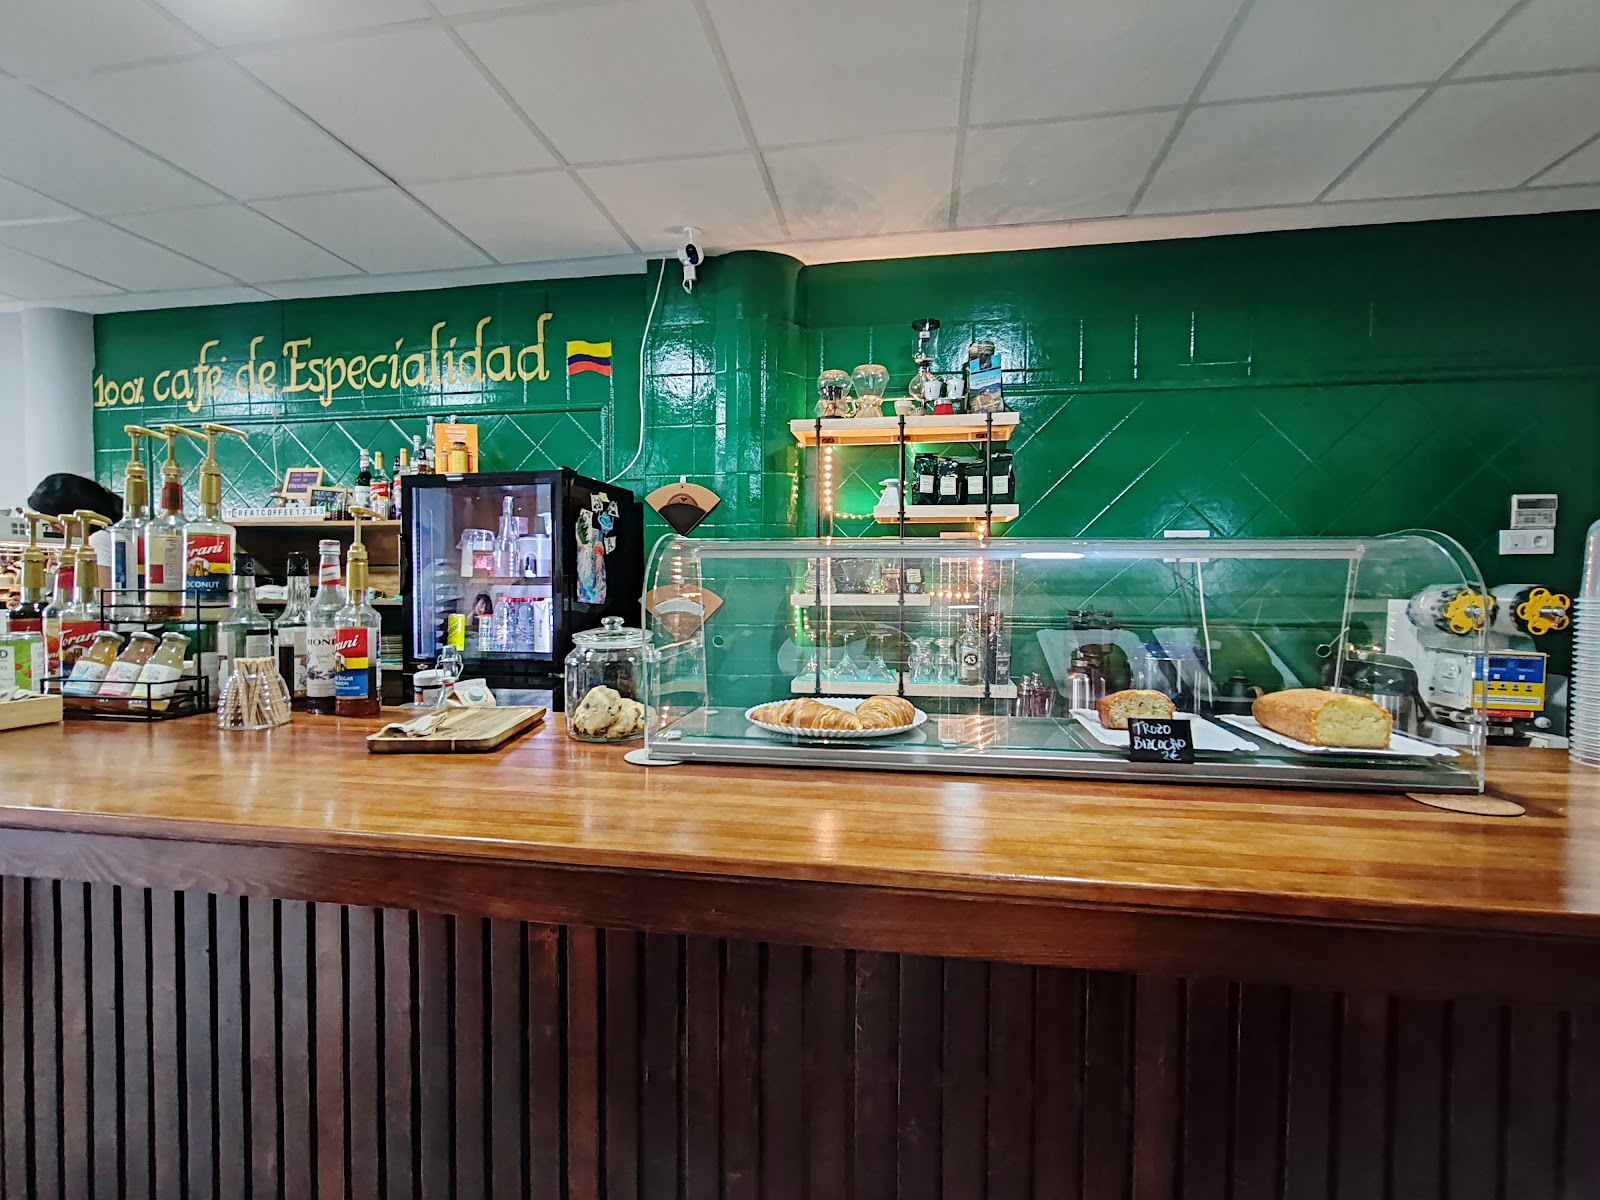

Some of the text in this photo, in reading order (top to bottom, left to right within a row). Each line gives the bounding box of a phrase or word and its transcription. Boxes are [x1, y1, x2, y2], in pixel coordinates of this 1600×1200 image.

[93, 312, 553, 413] 100% café de Especialidad
[187, 580, 220, 589] OCONUT
[58, 628, 96, 647] Toran
[307, 638, 335, 646] MONI
[335, 634, 359, 650] rani
[964, 655, 978, 664] 43
[1160, 750, 1182, 761] 2€
